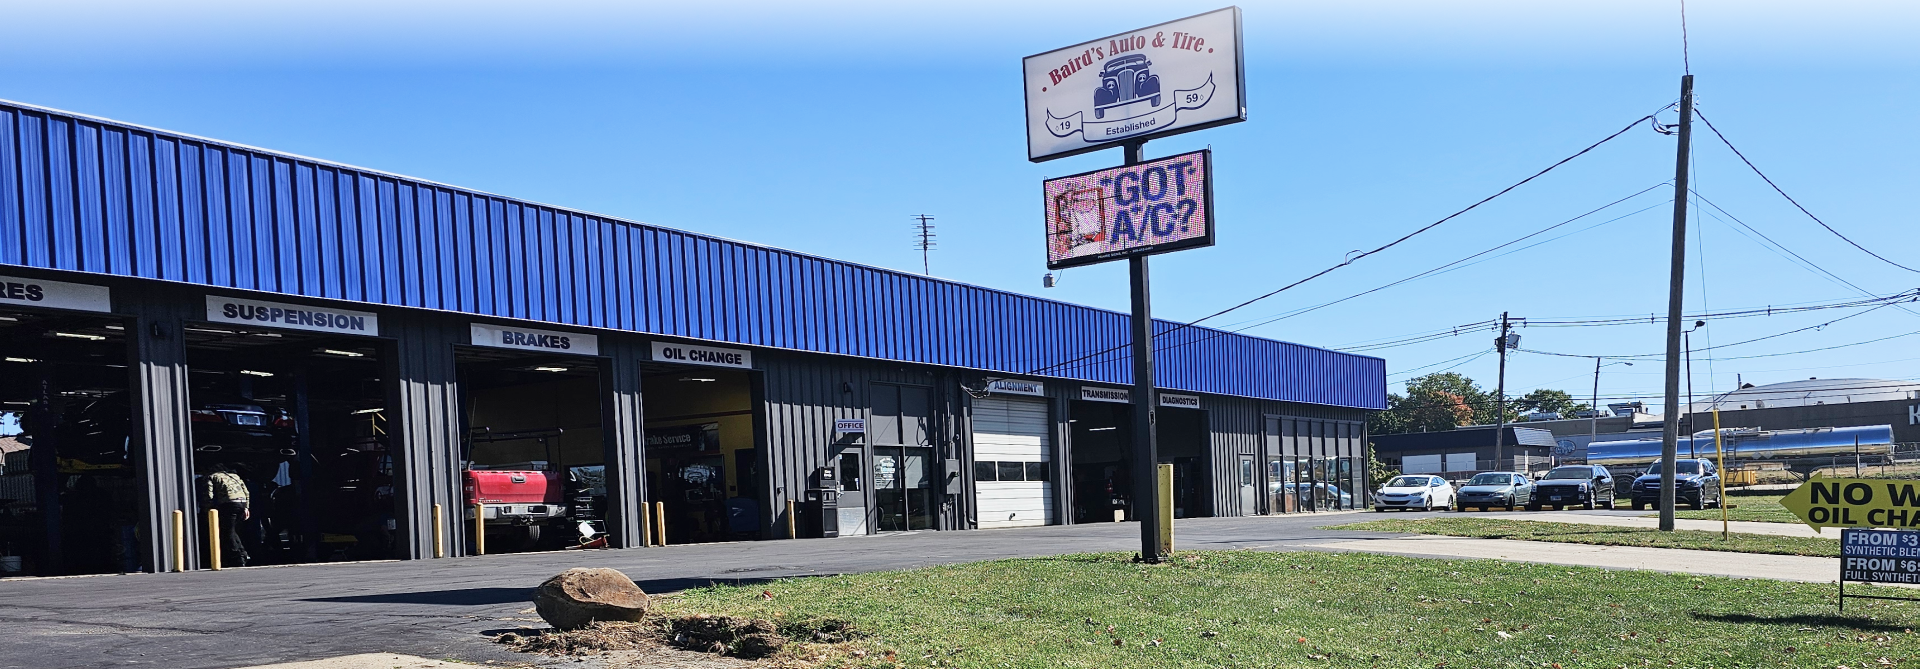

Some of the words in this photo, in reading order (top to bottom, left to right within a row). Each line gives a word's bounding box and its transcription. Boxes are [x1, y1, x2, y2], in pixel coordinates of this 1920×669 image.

[1048, 47, 1105, 86] Baird's
[1109, 34, 1146, 56] Auto
[1152, 31, 1166, 48] &
[1171, 32, 1205, 52] Tire
[1186, 93, 1199, 104] 59
[1059, 120, 1071, 131] 19
[1105, 117, 1156, 136] Established
[1114, 161, 1193, 206] GOT
[1109, 198, 1197, 244] A/C?
[223, 303, 365, 331] SUSPENSION
[502, 331, 571, 349] BRAKES
[662, 347, 686, 360] OIL
[689, 349, 742, 365] CHANGE
[994, 380, 1038, 393] ALIGNMENT
[1082, 389, 1128, 402] TRANSMISSION
[1162, 396, 1198, 406] DIAGNOSTICS
[645, 434, 663, 446] rake
[662, 433, 691, 445] Service
[1810, 482, 1873, 505] NO
[1808, 507, 1857, 525] OIL
[1848, 532, 1897, 546] FROM
[1845, 545, 1896, 556] SYNTHETIC
[1846, 557, 1895, 571] FROM
[1900, 560, 1920, 573] $6
[1845, 570, 1869, 580] FULL
